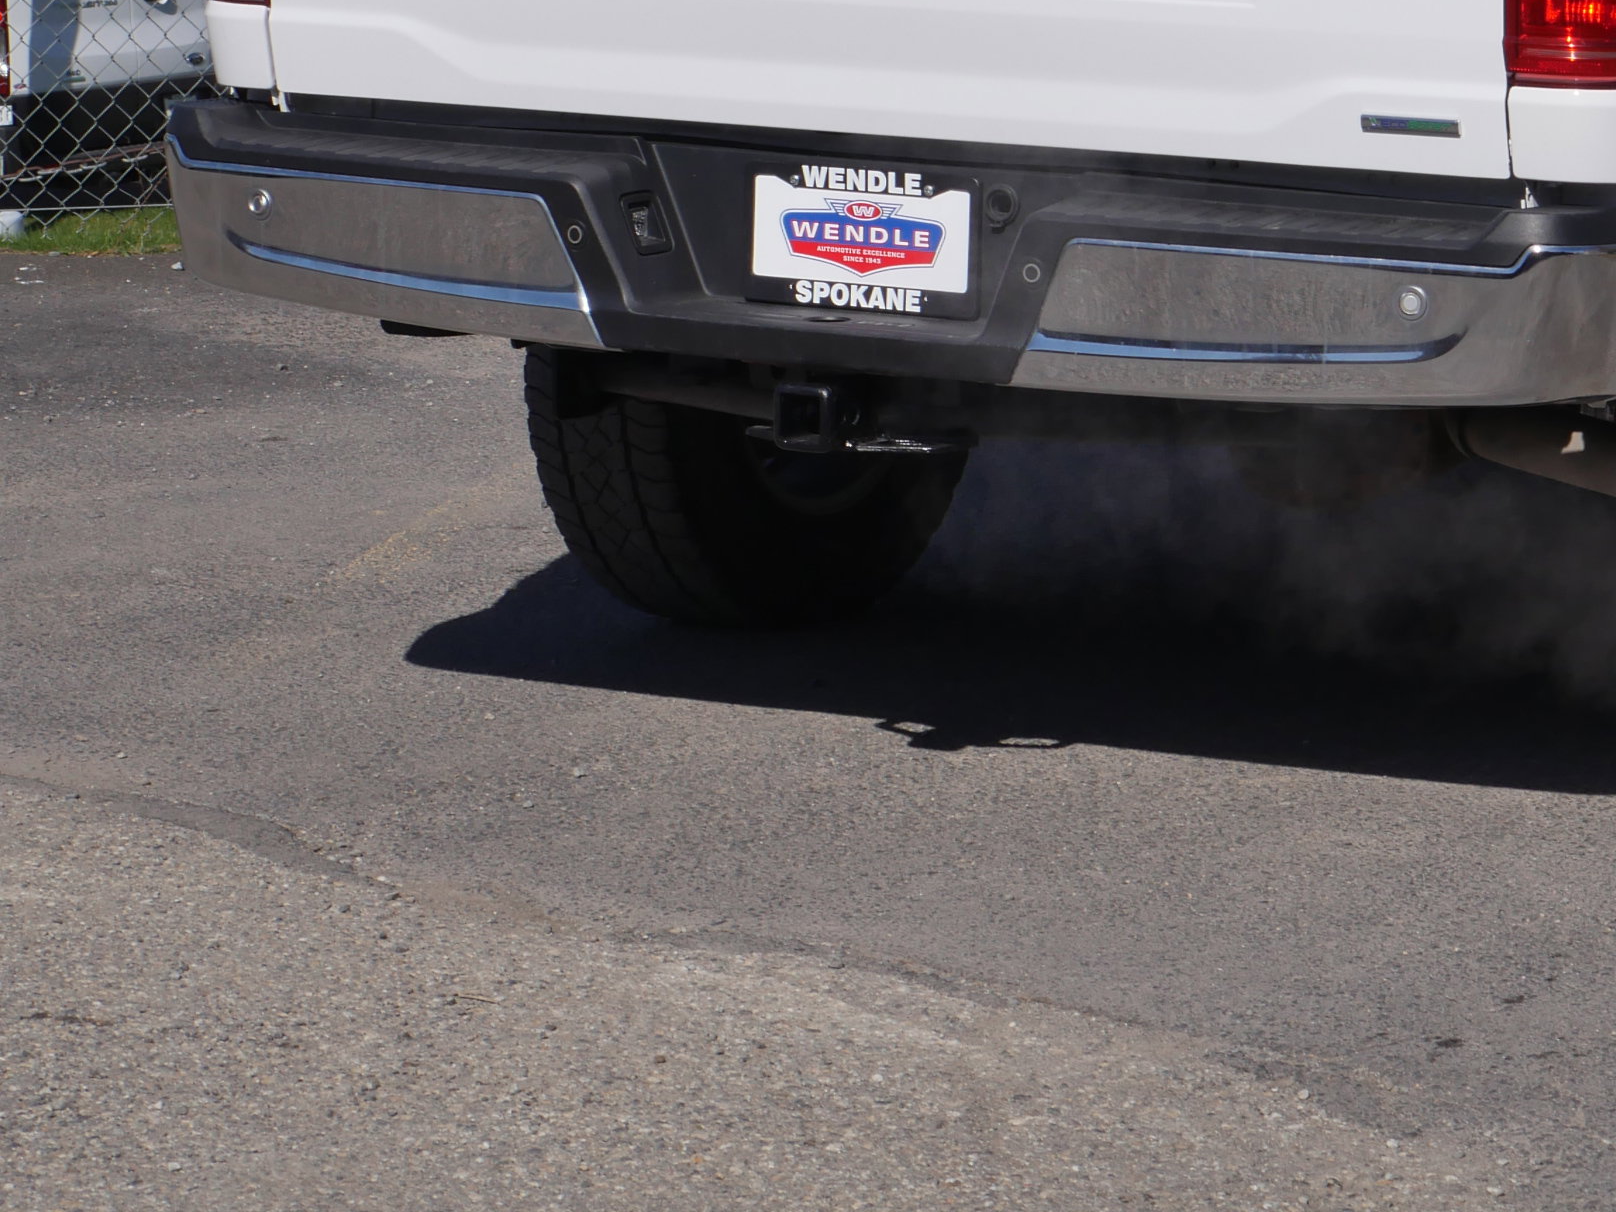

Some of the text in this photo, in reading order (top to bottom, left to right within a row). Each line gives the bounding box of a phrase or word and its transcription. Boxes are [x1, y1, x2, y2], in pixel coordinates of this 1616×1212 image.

[801, 164, 922, 196] WENDLE
[791, 220, 930, 248] WENDLE
[816, 245, 905, 259] AUTOMOTIVE EXCELLENCE
[843, 255, 864, 263] SINCE
[795, 279, 922, 313] SPOKANE
